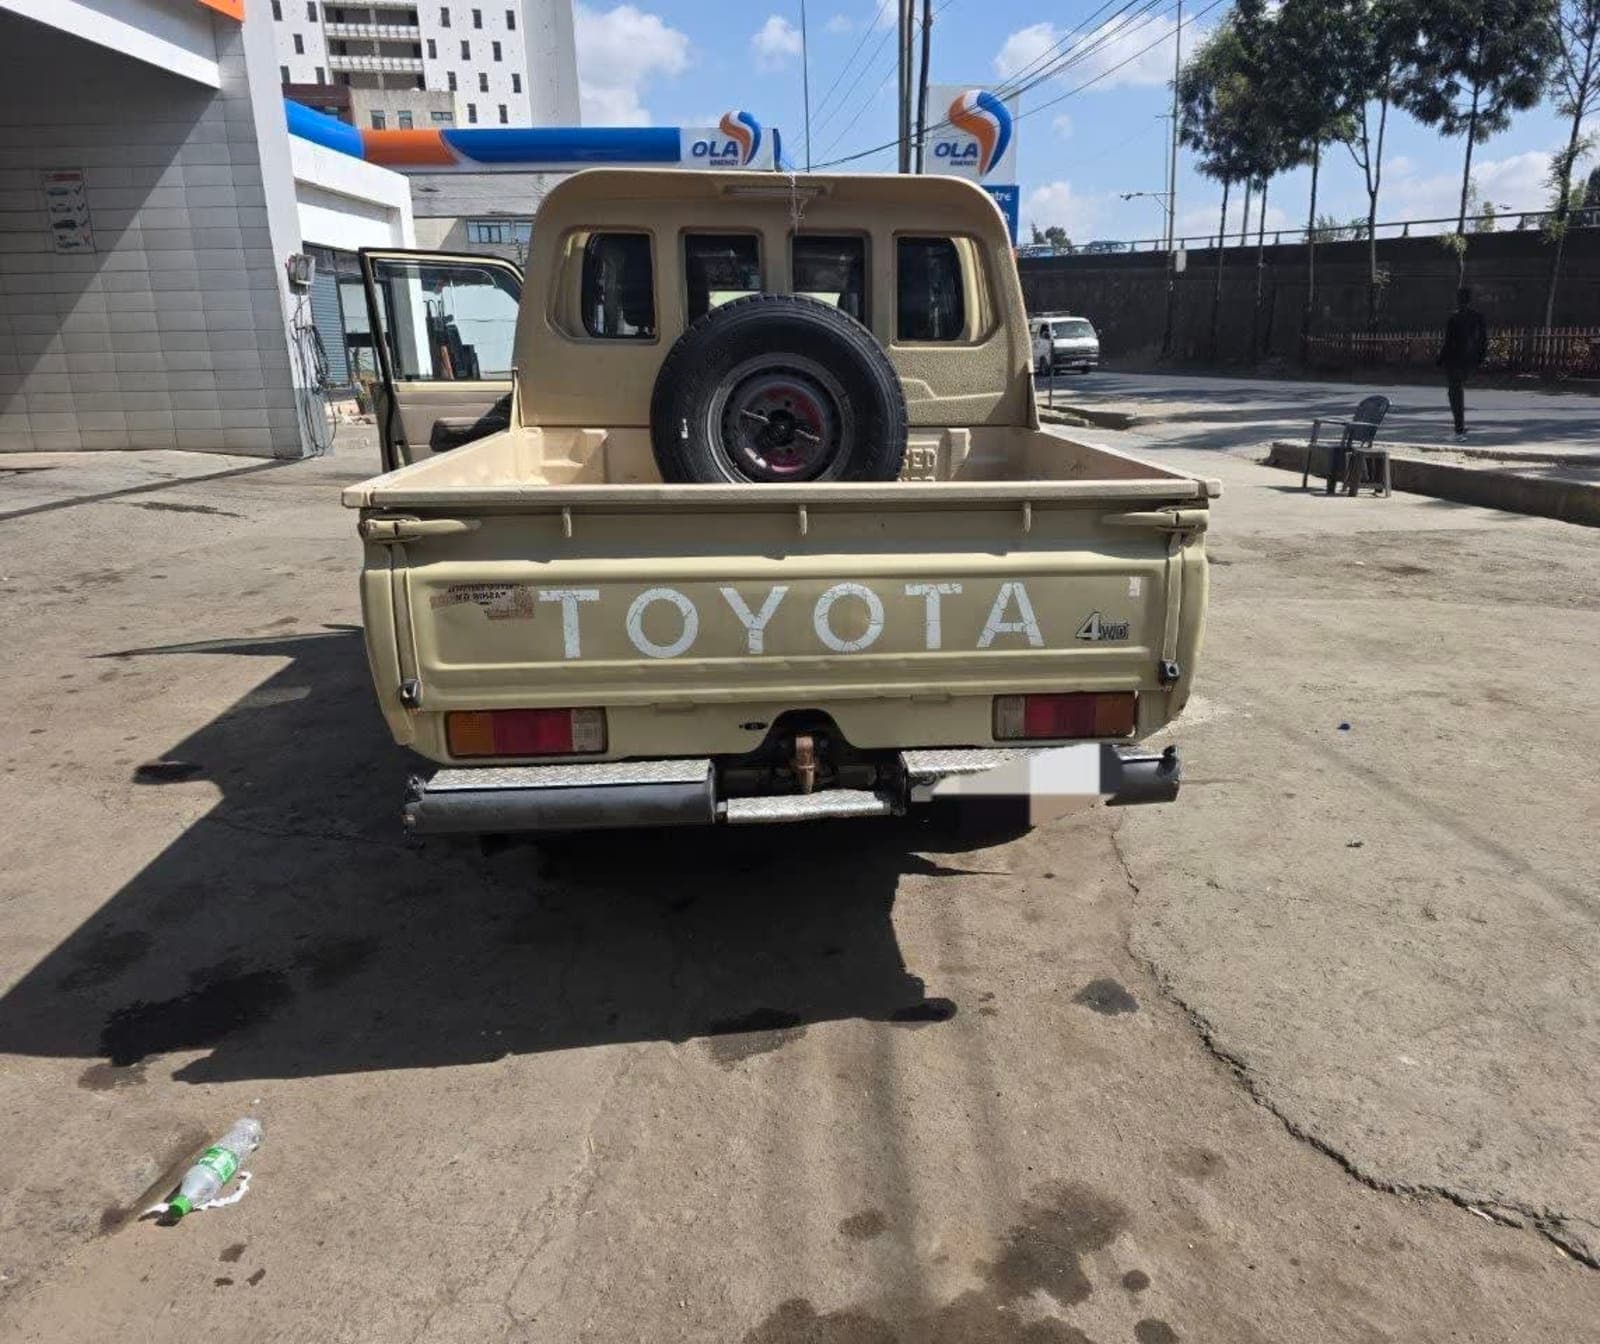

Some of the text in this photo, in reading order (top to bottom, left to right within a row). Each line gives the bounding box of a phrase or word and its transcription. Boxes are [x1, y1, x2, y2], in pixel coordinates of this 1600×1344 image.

[692, 141, 739, 157] OLA
[934, 142, 978, 158] OLA
[538, 581, 1045, 659] TOYOTA
[1075, 611, 1129, 641] 4WD
